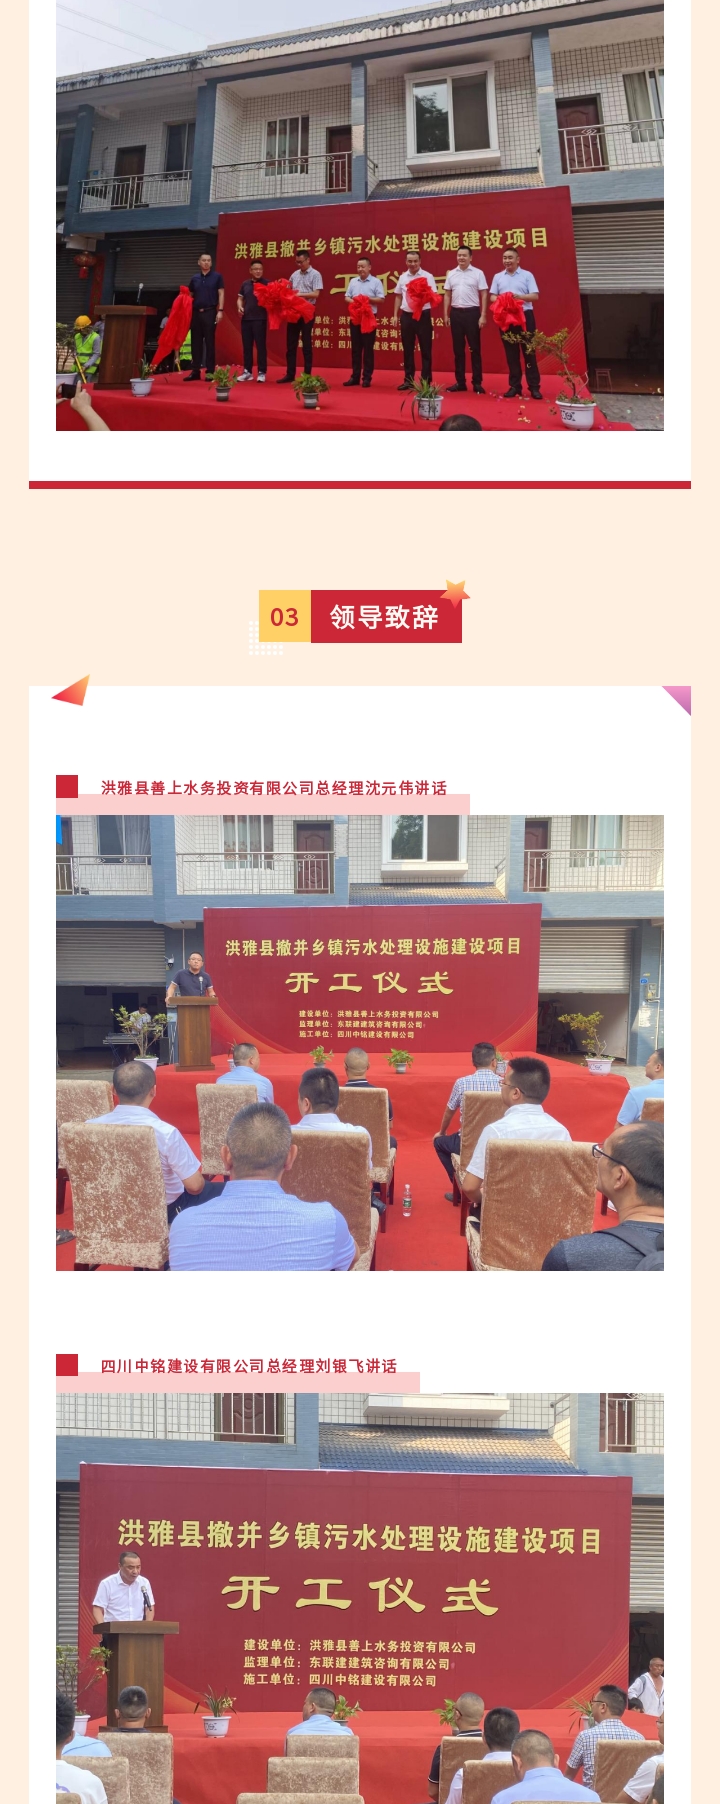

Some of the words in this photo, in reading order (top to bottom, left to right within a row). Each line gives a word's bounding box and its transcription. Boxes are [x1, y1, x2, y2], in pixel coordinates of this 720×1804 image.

[234, 227, 549, 260] 洪雅县撤并乡镇污水处理设施建设项目
[271, 608, 298, 626] 03
[330, 605, 437, 630] 领导致辞
[101, 780, 447, 796] 洪雅县善上水务投资有限公司总经理沈元伟讲话
[225, 937, 521, 956] 洪雅县撤并乡镇污水处理设施建设项目
[285, 971, 454, 995] 开工仪式
[101, 1358, 397, 1374] 四川中铭建设有限公司总经理刘银飞讲话
[118, 1519, 601, 1555] 洪雅县撤并乡镇污水处理设施建设项目
[221, 1576, 499, 1616] 开工仪式
